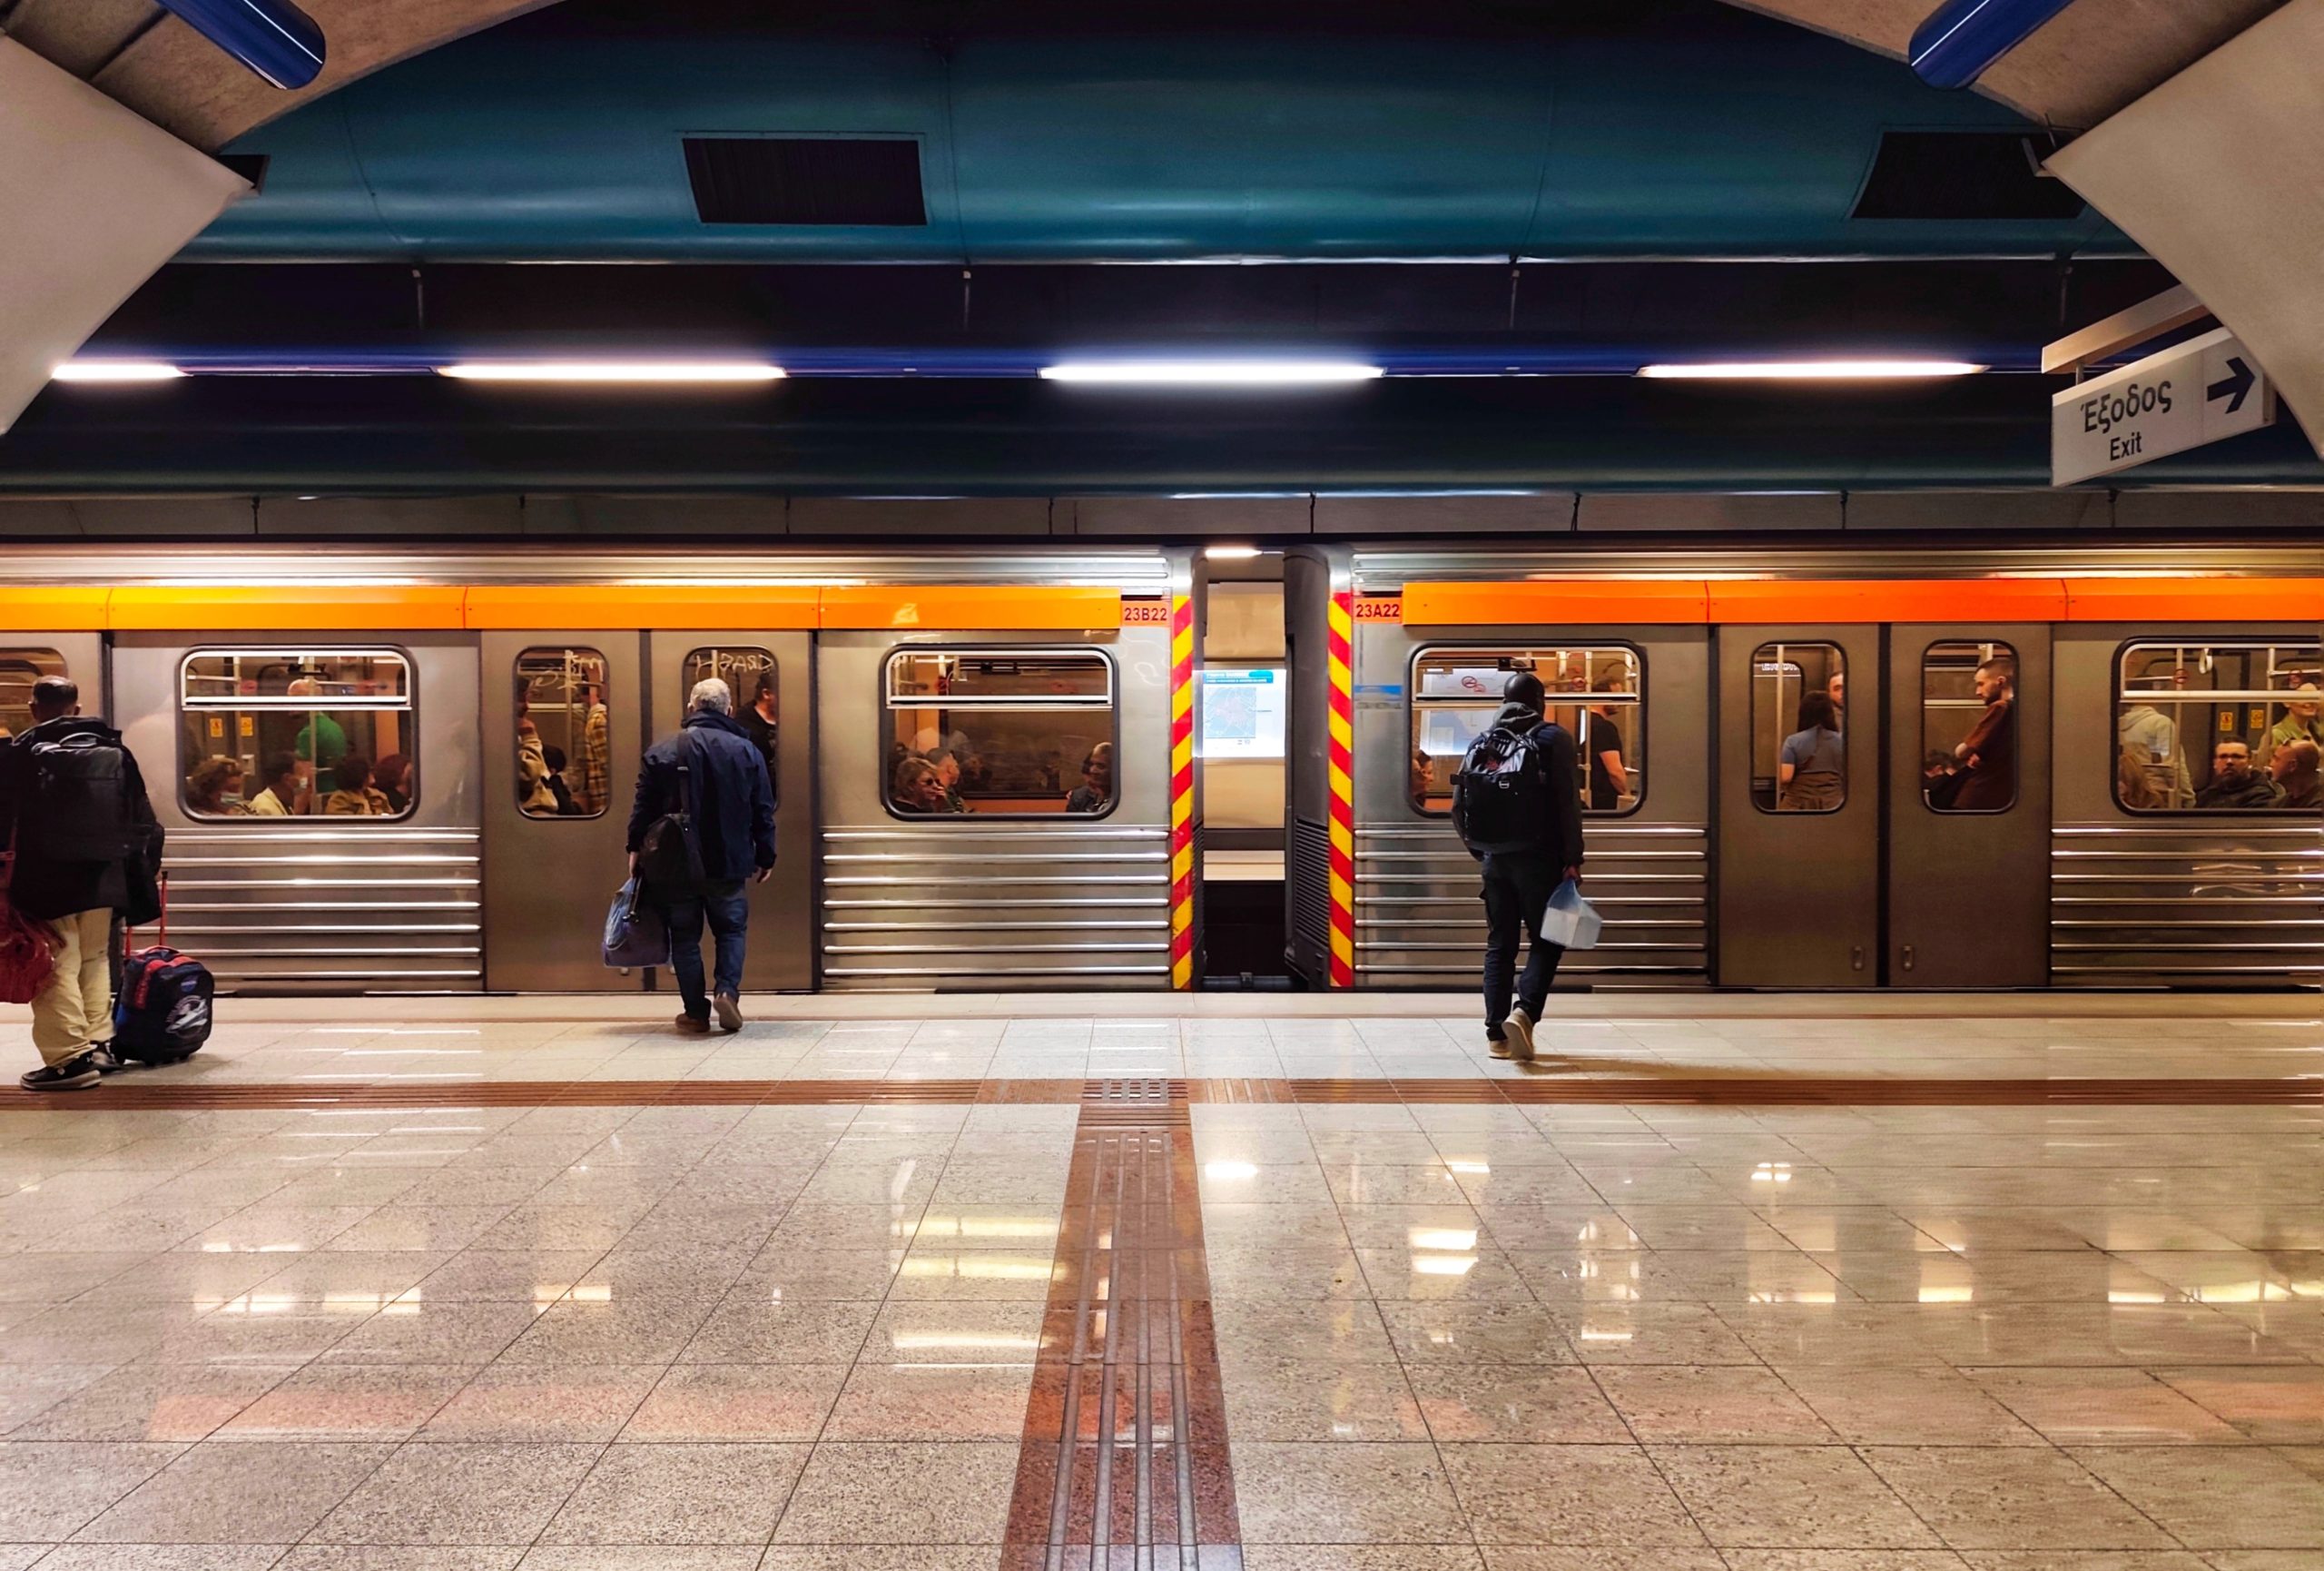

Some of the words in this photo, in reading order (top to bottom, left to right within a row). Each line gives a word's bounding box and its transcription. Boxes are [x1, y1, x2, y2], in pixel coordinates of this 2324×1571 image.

[2080, 380, 2172, 434] Έξοδος
[2109, 431, 2142, 461] Exit
[1124, 607, 1167, 621] 23B22
[1355, 603, 1400, 618] 23A22
